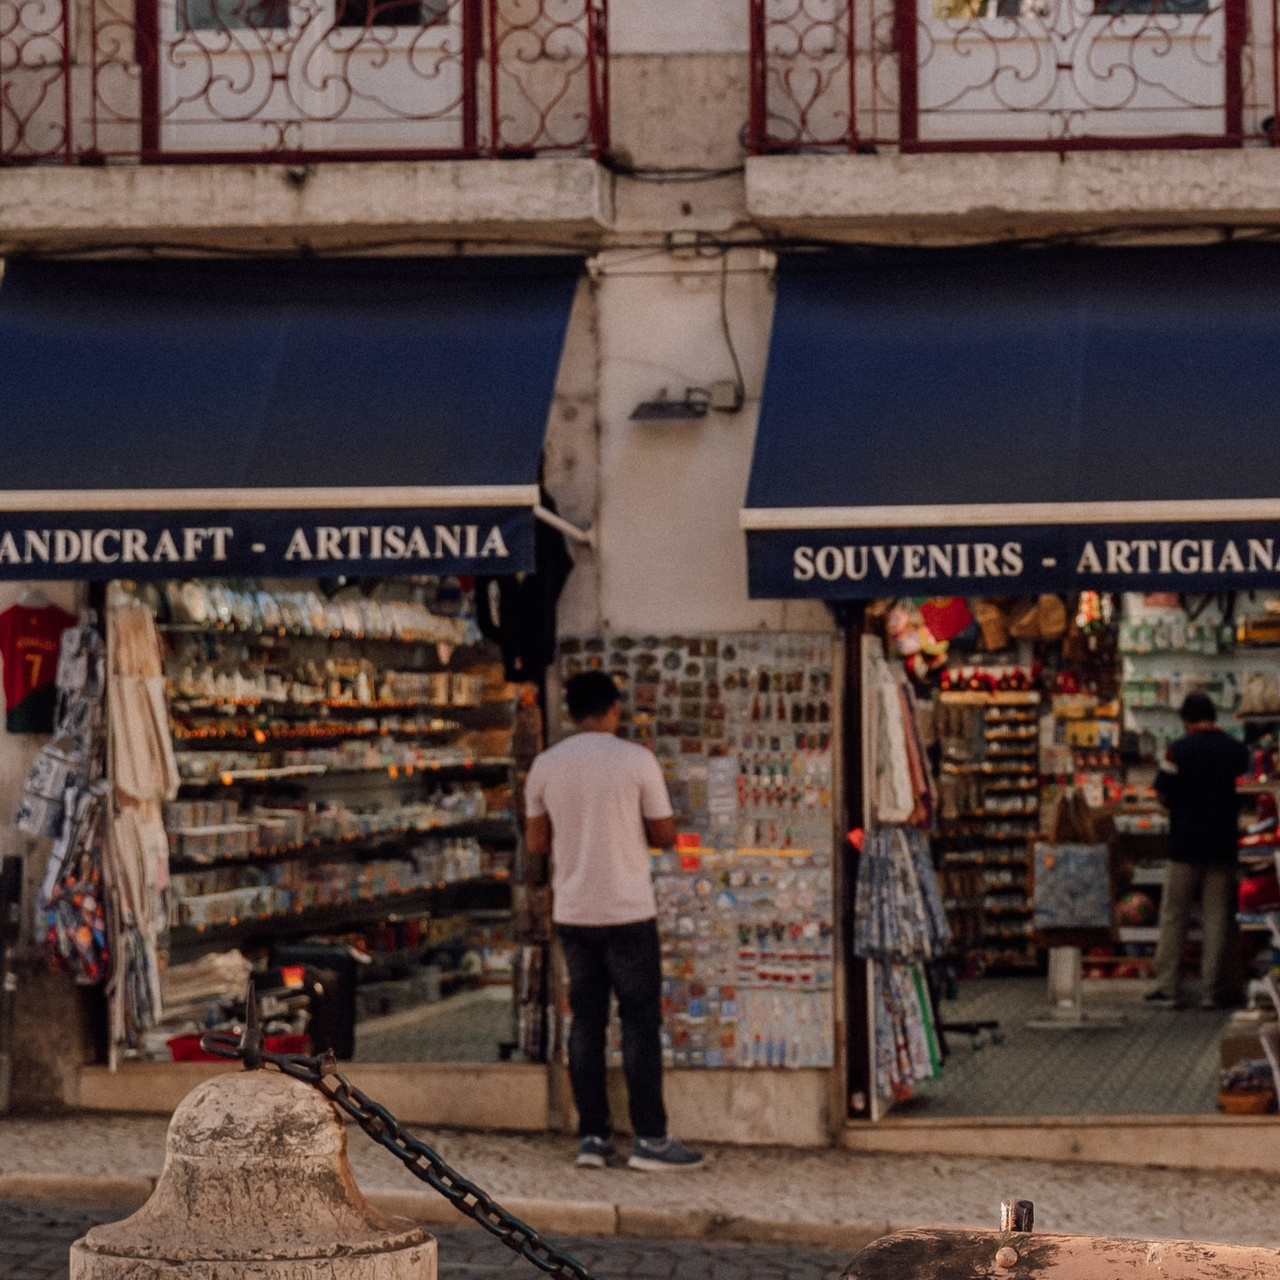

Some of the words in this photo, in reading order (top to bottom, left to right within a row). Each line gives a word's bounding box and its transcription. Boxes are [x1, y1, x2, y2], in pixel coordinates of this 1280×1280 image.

[0, 527, 234, 564] ANDICRAFT
[251, 542, 267, 553] -
[284, 524, 510, 561] ARTISANIA
[793, 541, 1024, 581] SOUVENIRS
[1041, 556, 1057, 568] -
[25, 653, 43, 688] 7
